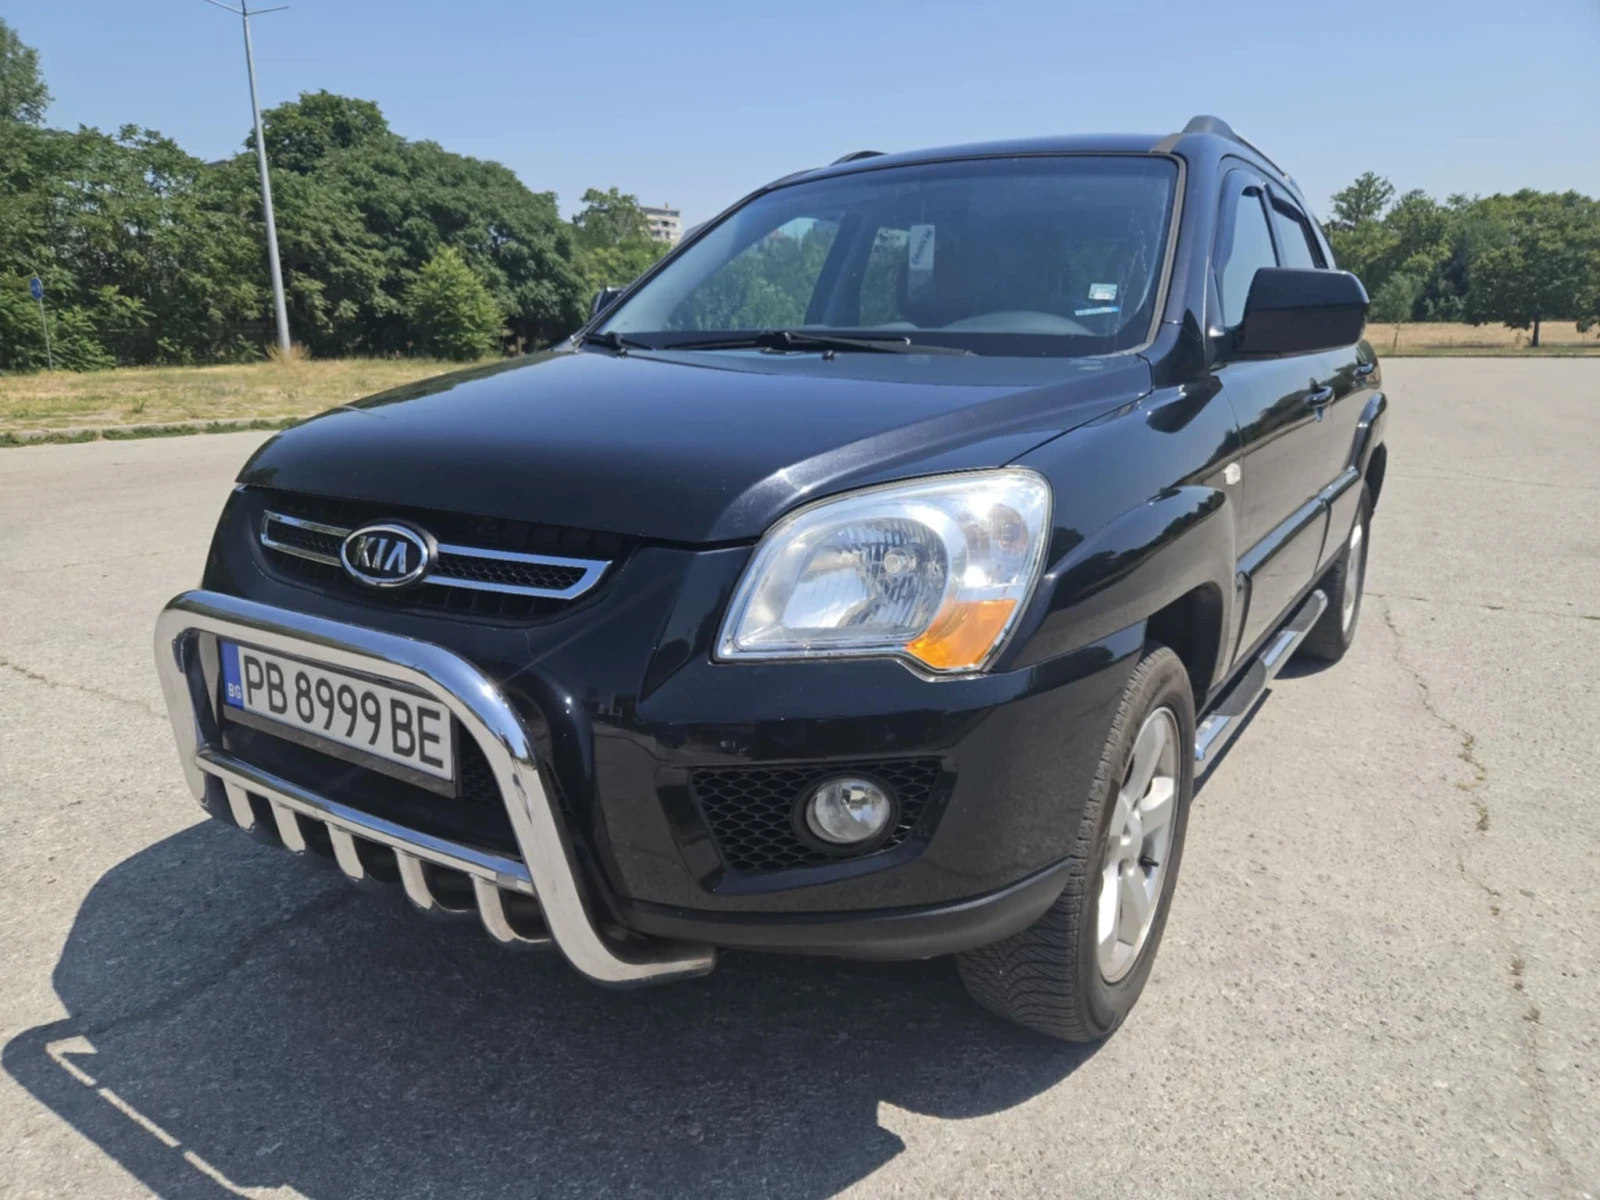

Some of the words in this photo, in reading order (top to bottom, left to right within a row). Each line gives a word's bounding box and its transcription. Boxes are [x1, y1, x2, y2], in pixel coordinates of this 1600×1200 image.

[354, 535, 408, 574] KIA
[228, 682, 242, 699] BG
[243, 654, 288, 715] PB
[295, 671, 382, 746] 8999
[390, 697, 444, 769] BE
